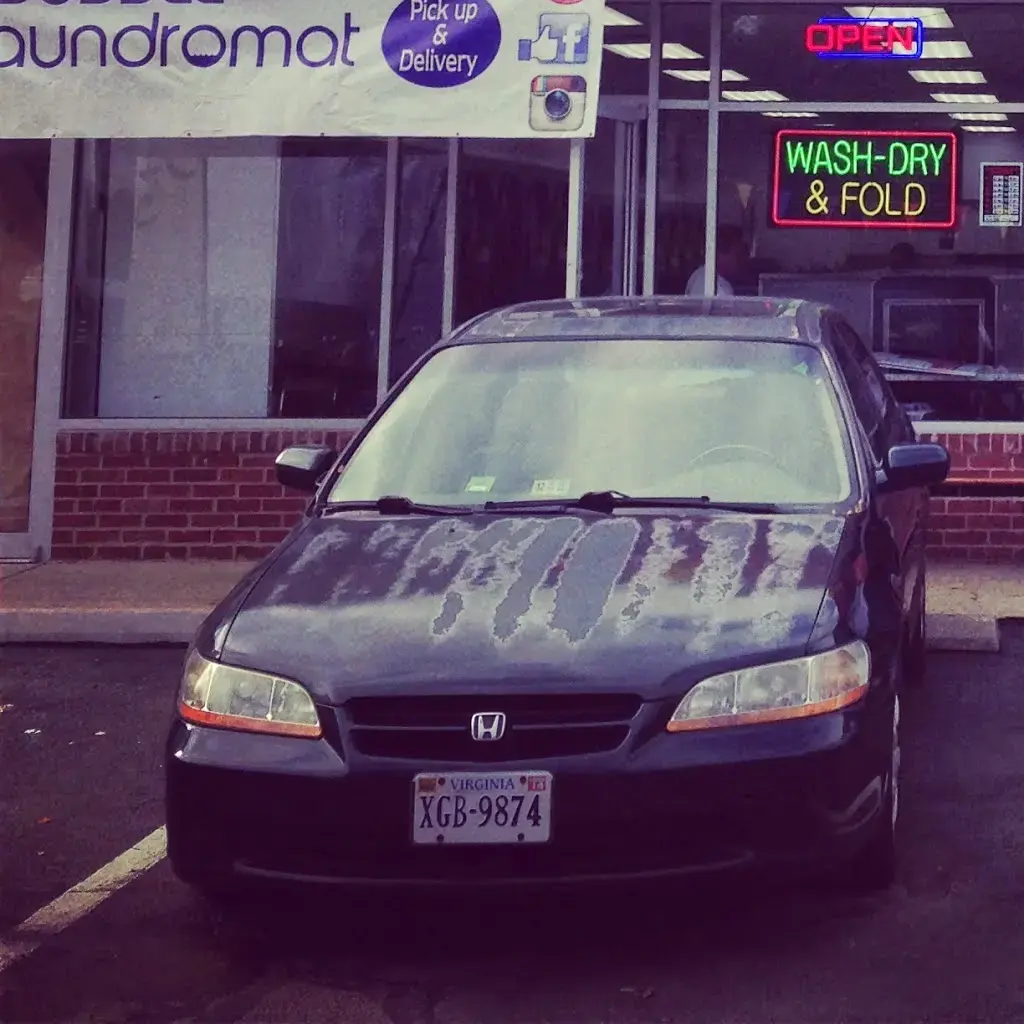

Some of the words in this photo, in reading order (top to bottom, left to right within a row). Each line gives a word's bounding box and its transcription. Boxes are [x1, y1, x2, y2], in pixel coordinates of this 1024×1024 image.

[454, 2, 478, 21] up
[432, 24, 448, 45] &
[805, 23, 915, 53] OPEN
[399, 49, 478, 76] Delivery
[786, 139, 947, 176] WASH-DRY
[805, 179, 829, 215] &
[841, 182, 927, 217] FOLD
[450, 778, 515, 791] VIRGINIA
[419, 795, 542, 828] XGB-9874
